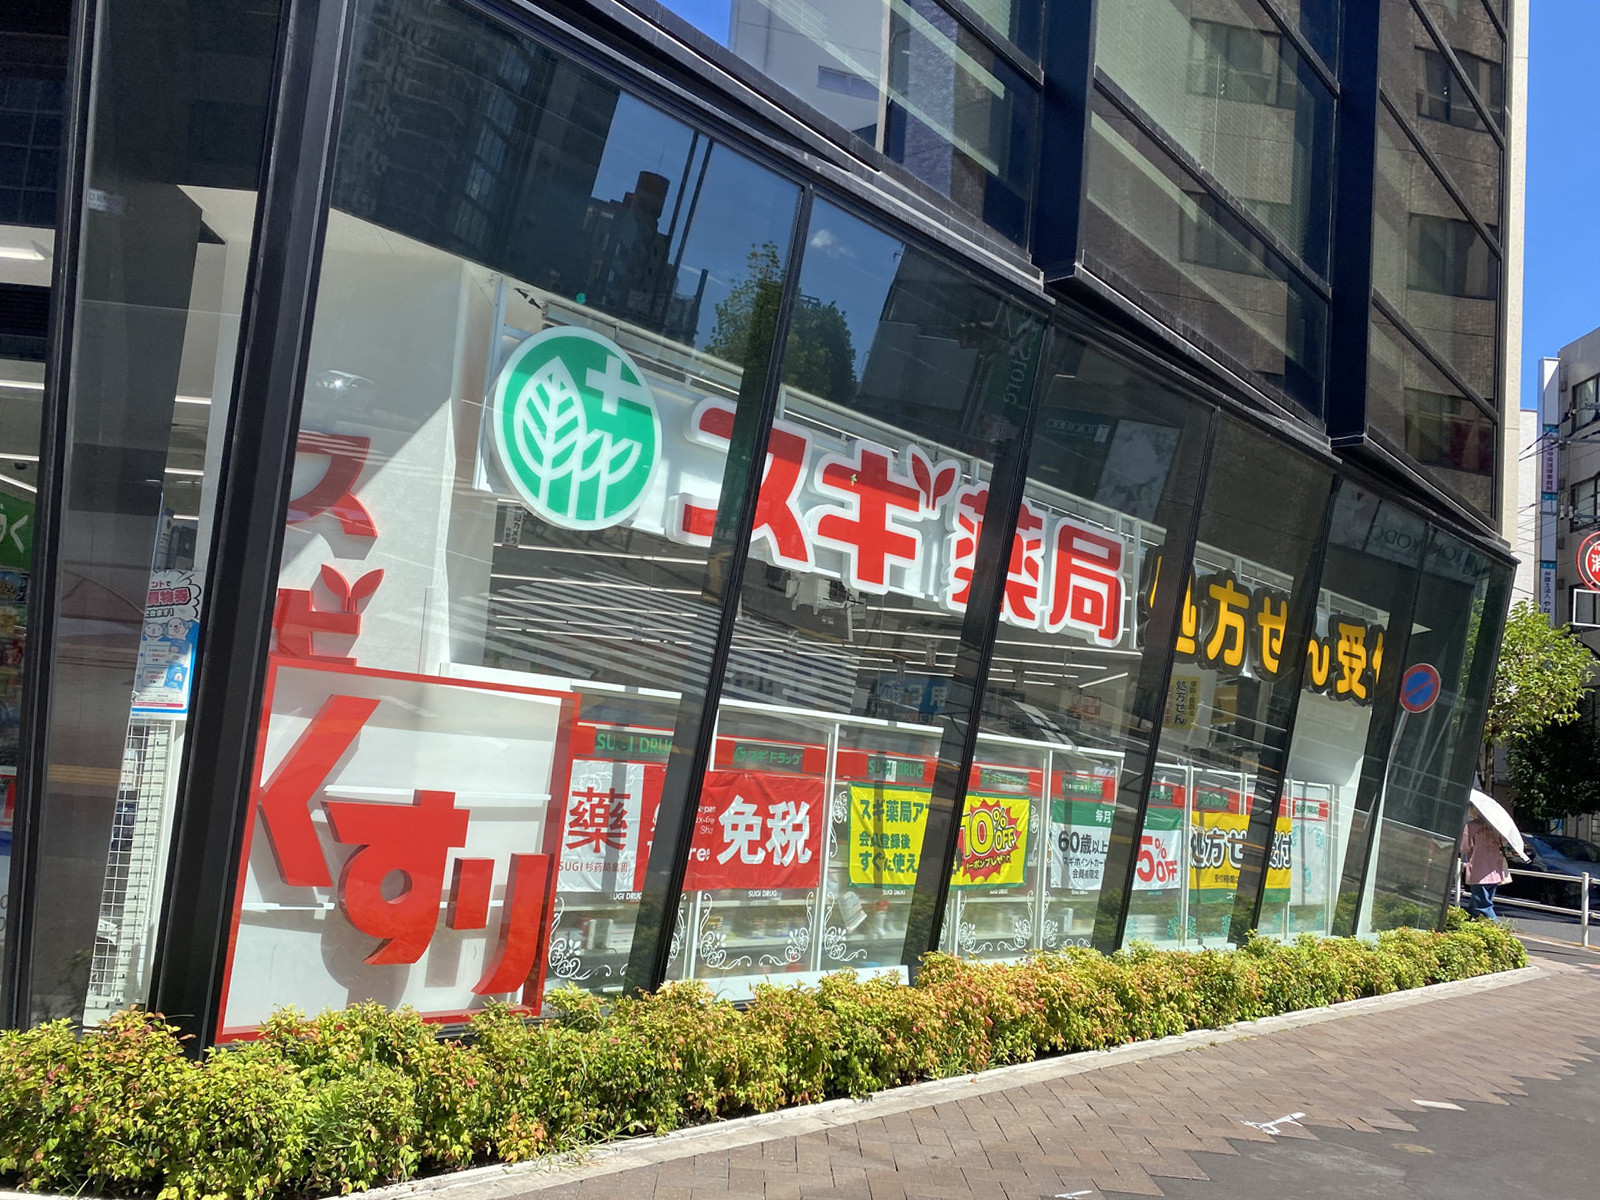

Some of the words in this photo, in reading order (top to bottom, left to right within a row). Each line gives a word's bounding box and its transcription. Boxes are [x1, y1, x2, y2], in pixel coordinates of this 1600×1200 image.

[680, 404, 1124, 643] スギ薬局
[257, 693, 549, 996] くすり
[716, 794, 813, 867] 免税
[995, 826, 1016, 851] OFF
[1058, 830, 1108, 855] 60歳以上
[559, 861, 583, 872] SUGI
